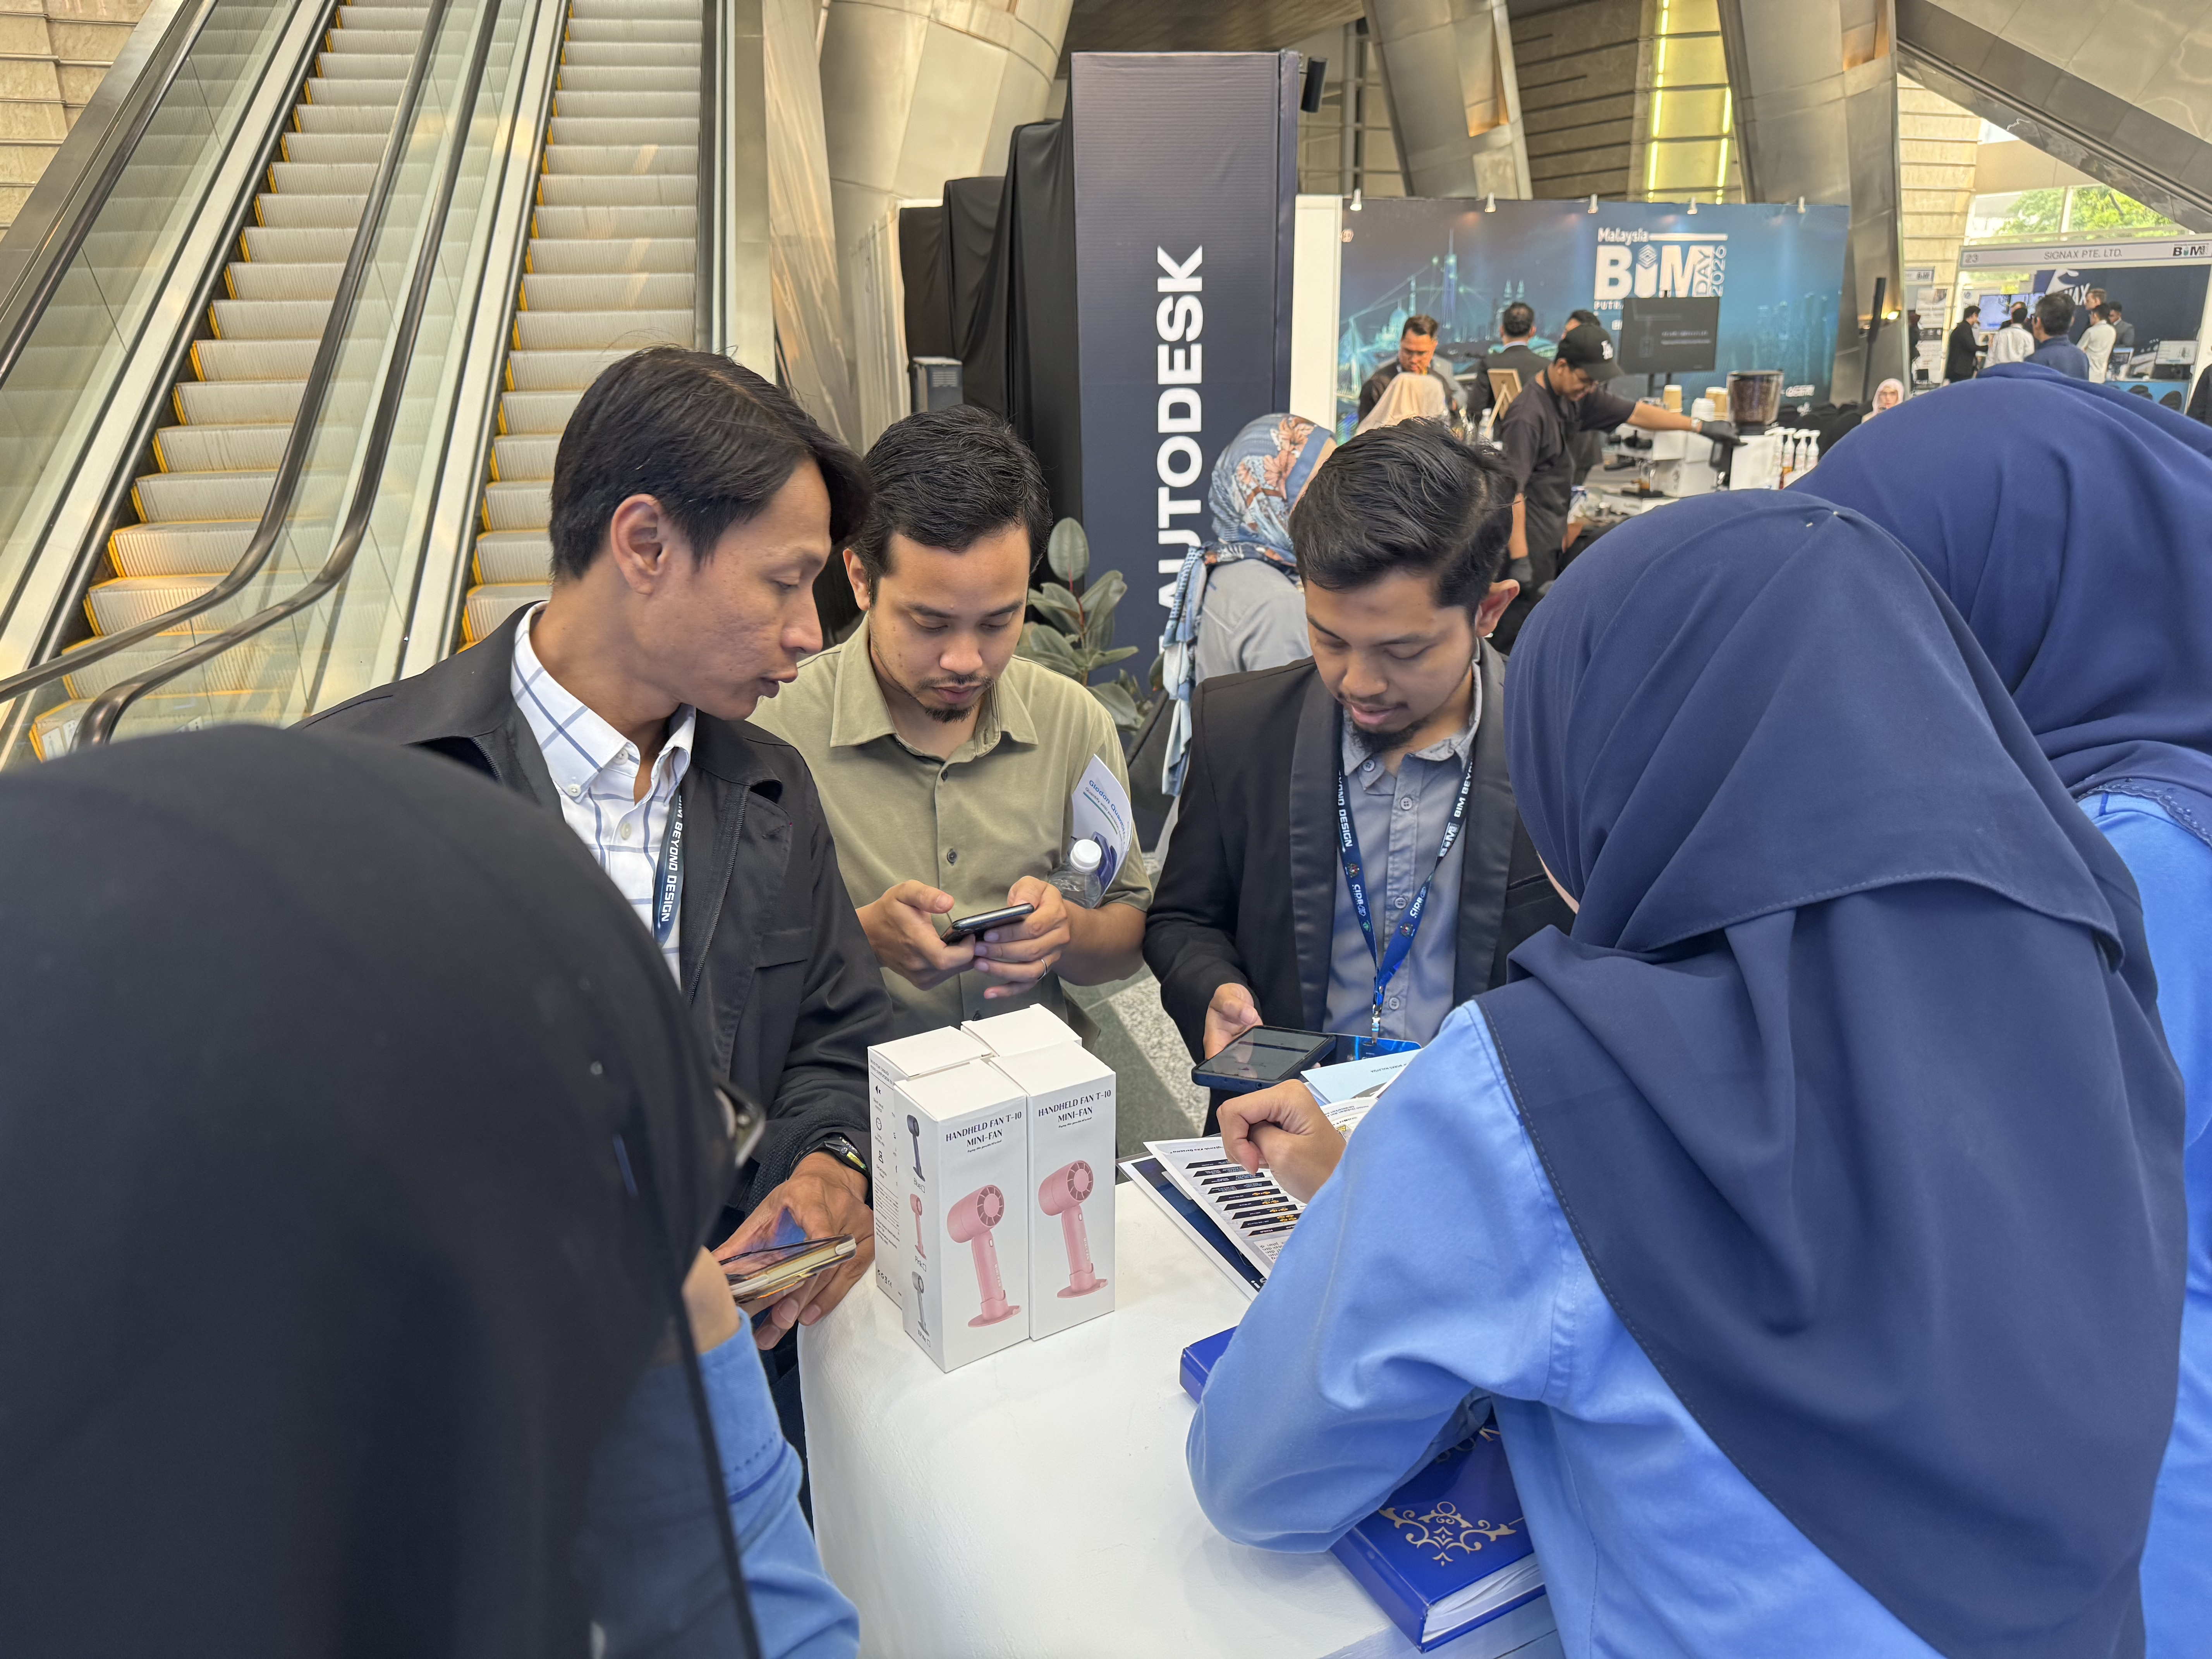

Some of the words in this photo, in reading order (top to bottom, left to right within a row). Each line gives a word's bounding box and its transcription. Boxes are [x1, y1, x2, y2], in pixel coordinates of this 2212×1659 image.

[1597, 227, 1649, 246] Malaysia
[2082, 249, 2100, 258] PTE.
[1695, 249, 1711, 296] DAY
[1709, 245, 1727, 297] 2026
[1089, 780, 1110, 804] Glodon
[1454, 797, 1466, 817] BIM
[1338, 809, 1353, 847] DESIGN
[669, 821, 683, 871] BEYOND
[661, 875, 677, 922] DESIGN
[1039, 1099, 1078, 1117] HANDHELD
[1080, 1094, 1094, 1104] FAN
[1096, 1090, 1111, 1100] T-10
[1058, 1106, 1093, 1123] MINI-FAN
[946, 1122, 988, 1142] HANDHELD
[990, 1116, 1004, 1128] FAN
[1006, 1111, 1022, 1122] T-10
[967, 1128, 1003, 1147] MINI-FAN
